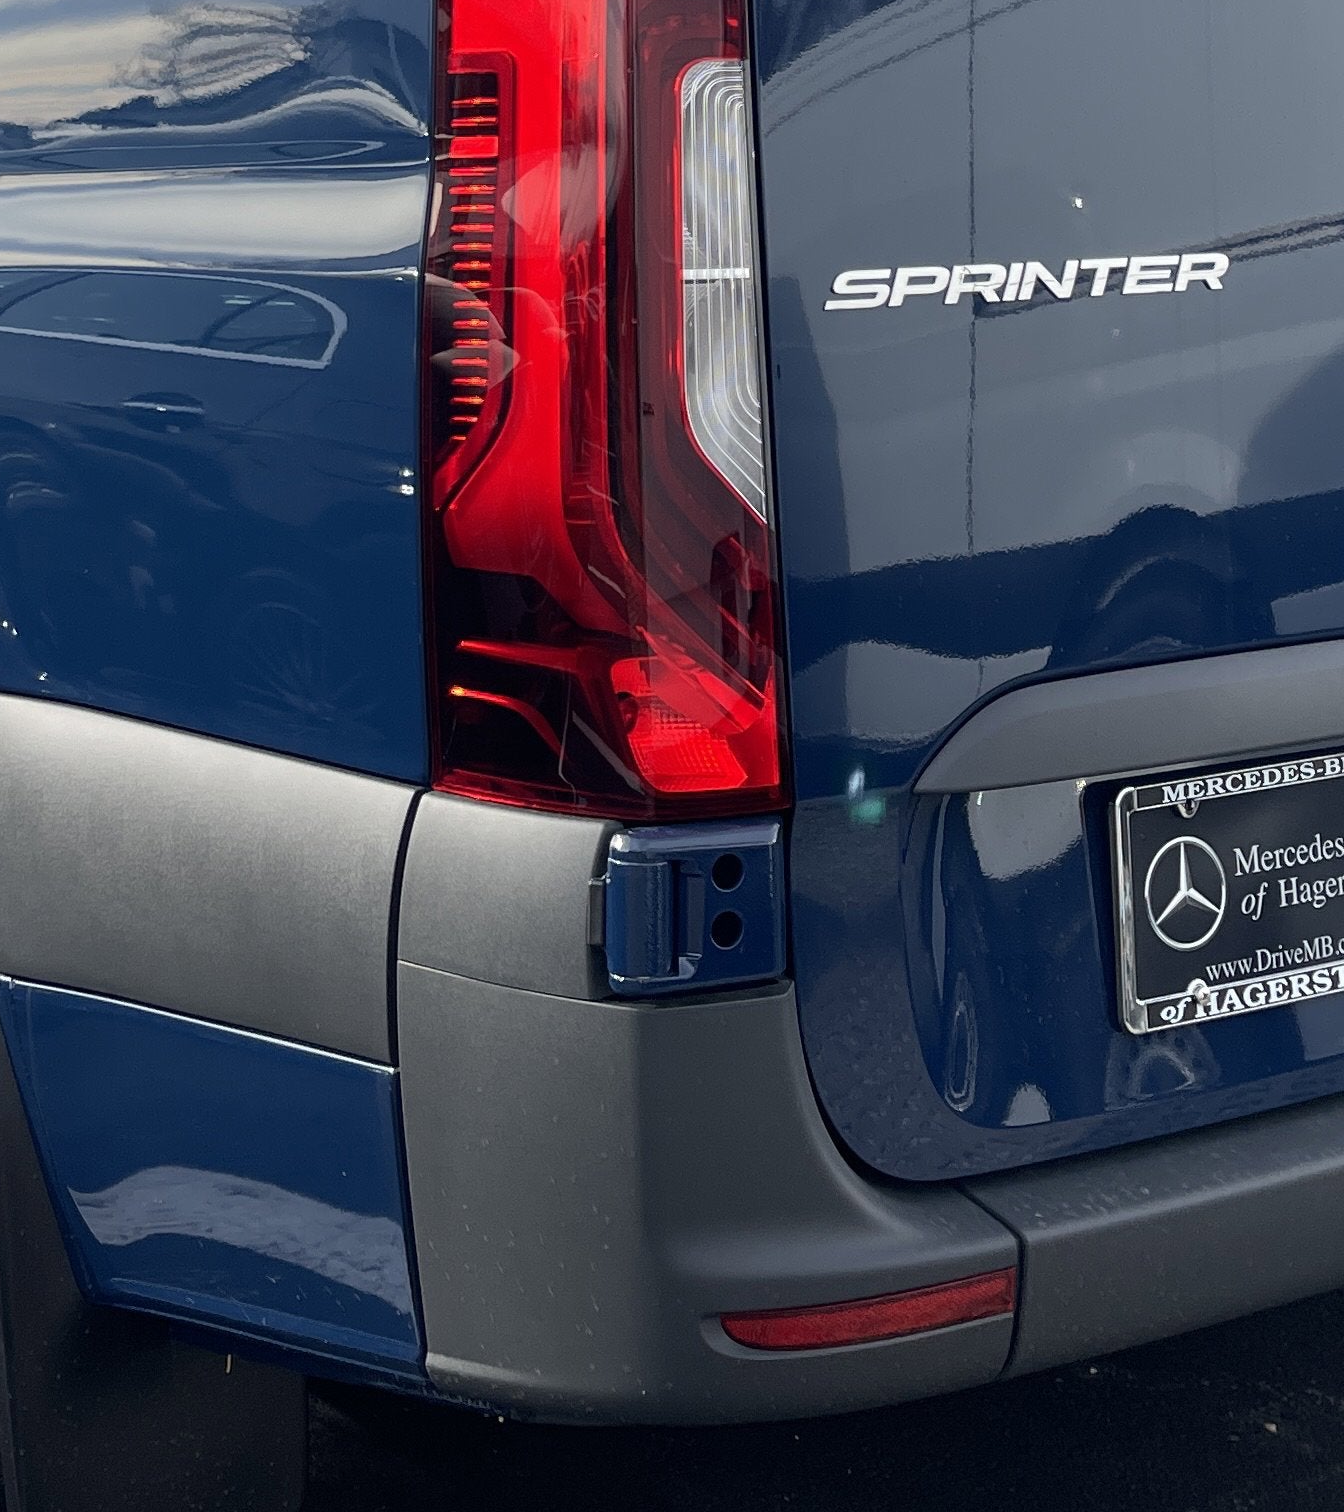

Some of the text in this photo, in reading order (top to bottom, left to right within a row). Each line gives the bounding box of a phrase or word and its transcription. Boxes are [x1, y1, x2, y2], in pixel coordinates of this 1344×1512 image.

[823, 252, 1230, 311] SPRINTER
[1241, 882, 1268, 921] of
[1160, 996, 1191, 1024] of
